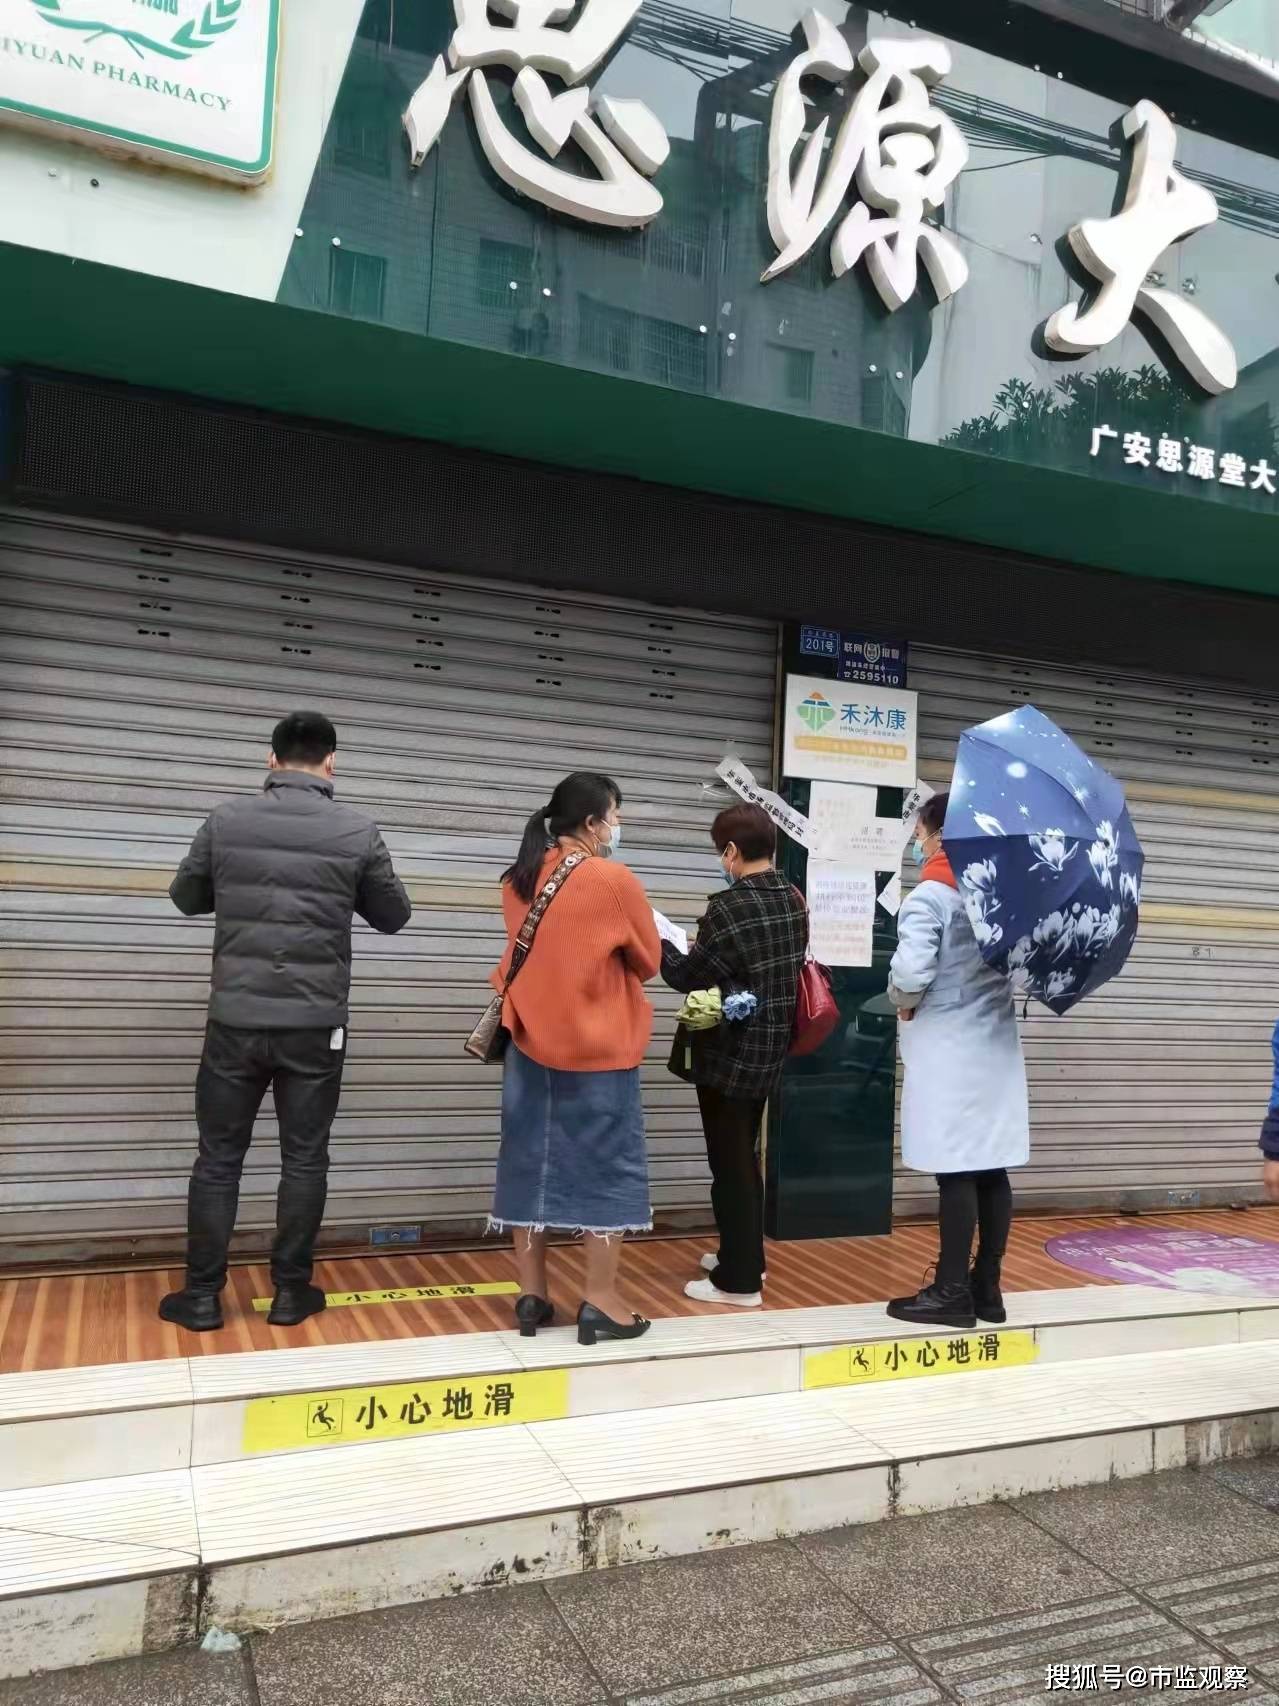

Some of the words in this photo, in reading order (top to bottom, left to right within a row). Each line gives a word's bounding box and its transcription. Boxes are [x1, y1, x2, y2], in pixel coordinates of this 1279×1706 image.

[92, 60, 232, 112] PHARMACY
[1089, 424, 1277, 494] 广安思源堂大
[806, 639, 833, 653] 201号
[852, 671, 898, 684] 2595110
[840, 703, 907, 730] 禾沐康
[346, 1286, 475, 1302] 小心地滑
[883, 1334, 1001, 1372] 小心地滑
[355, 1382, 515, 1430] 小心地滑
